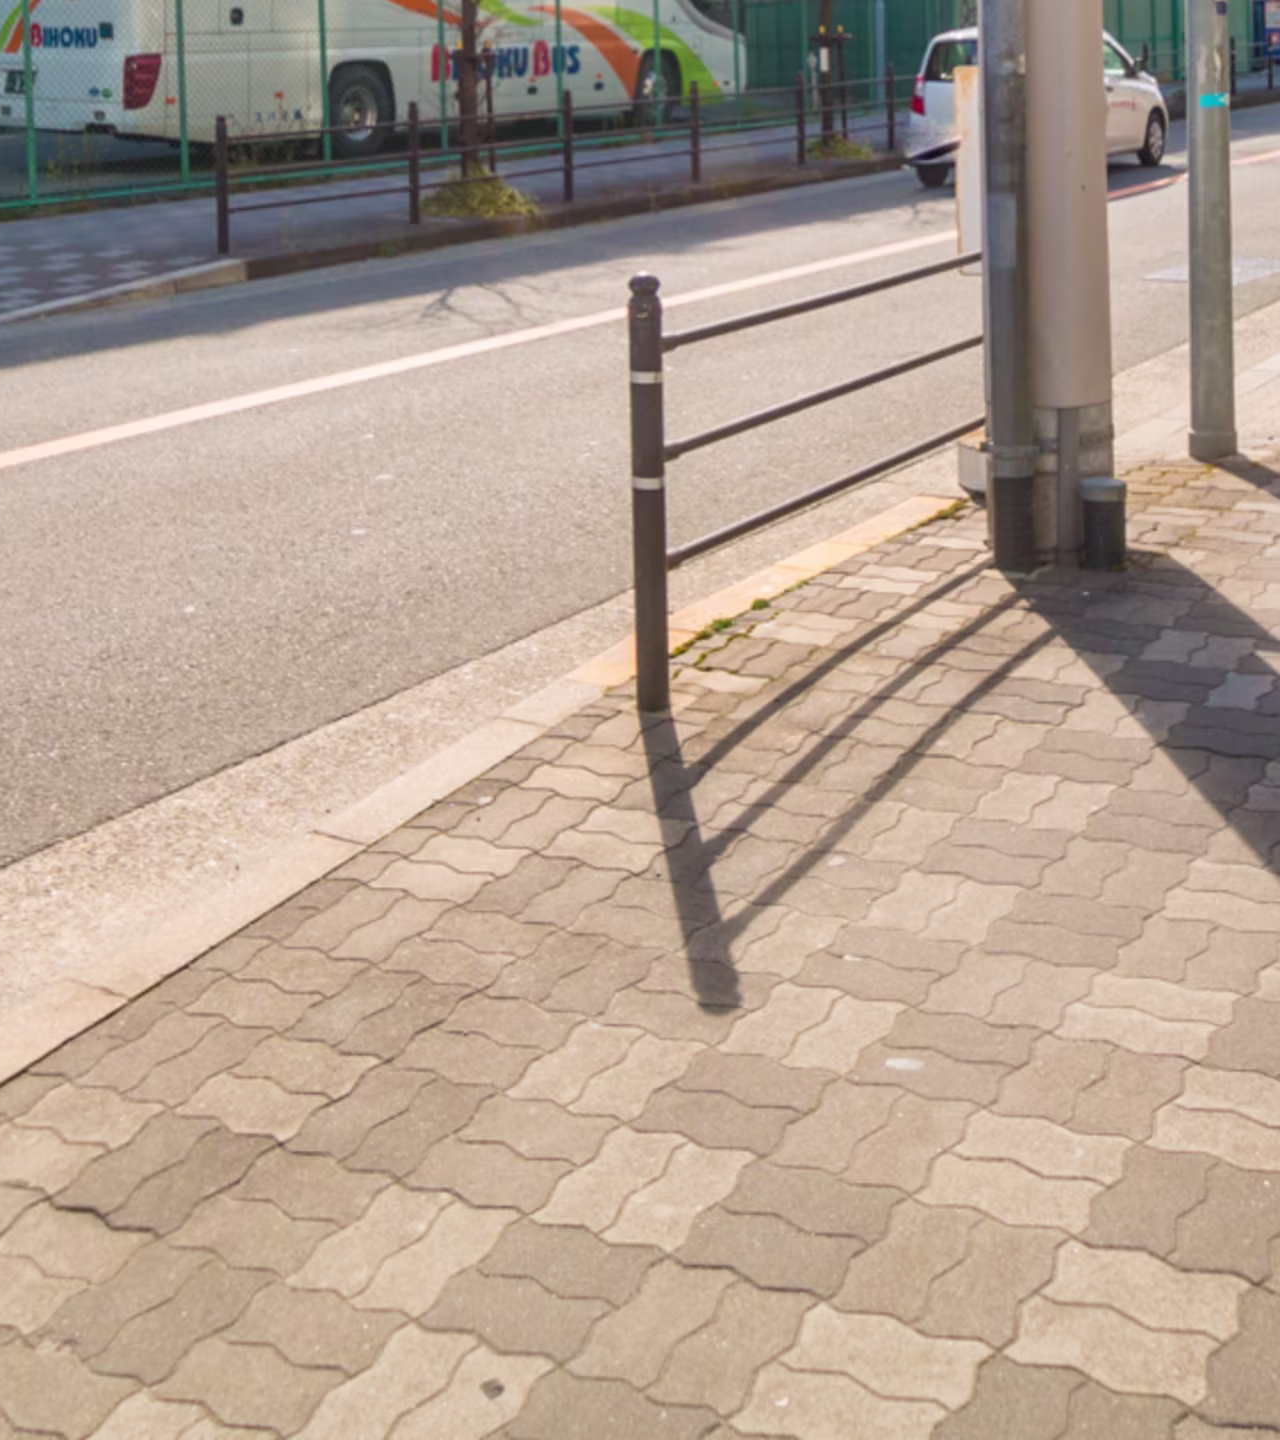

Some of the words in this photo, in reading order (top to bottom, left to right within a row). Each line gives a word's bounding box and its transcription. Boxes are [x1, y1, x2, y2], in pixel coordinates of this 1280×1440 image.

[29, 22, 98, 49] BIHOKU
[431, 43, 528, 81] BIOKU
[533, 39, 581, 76] BUS
